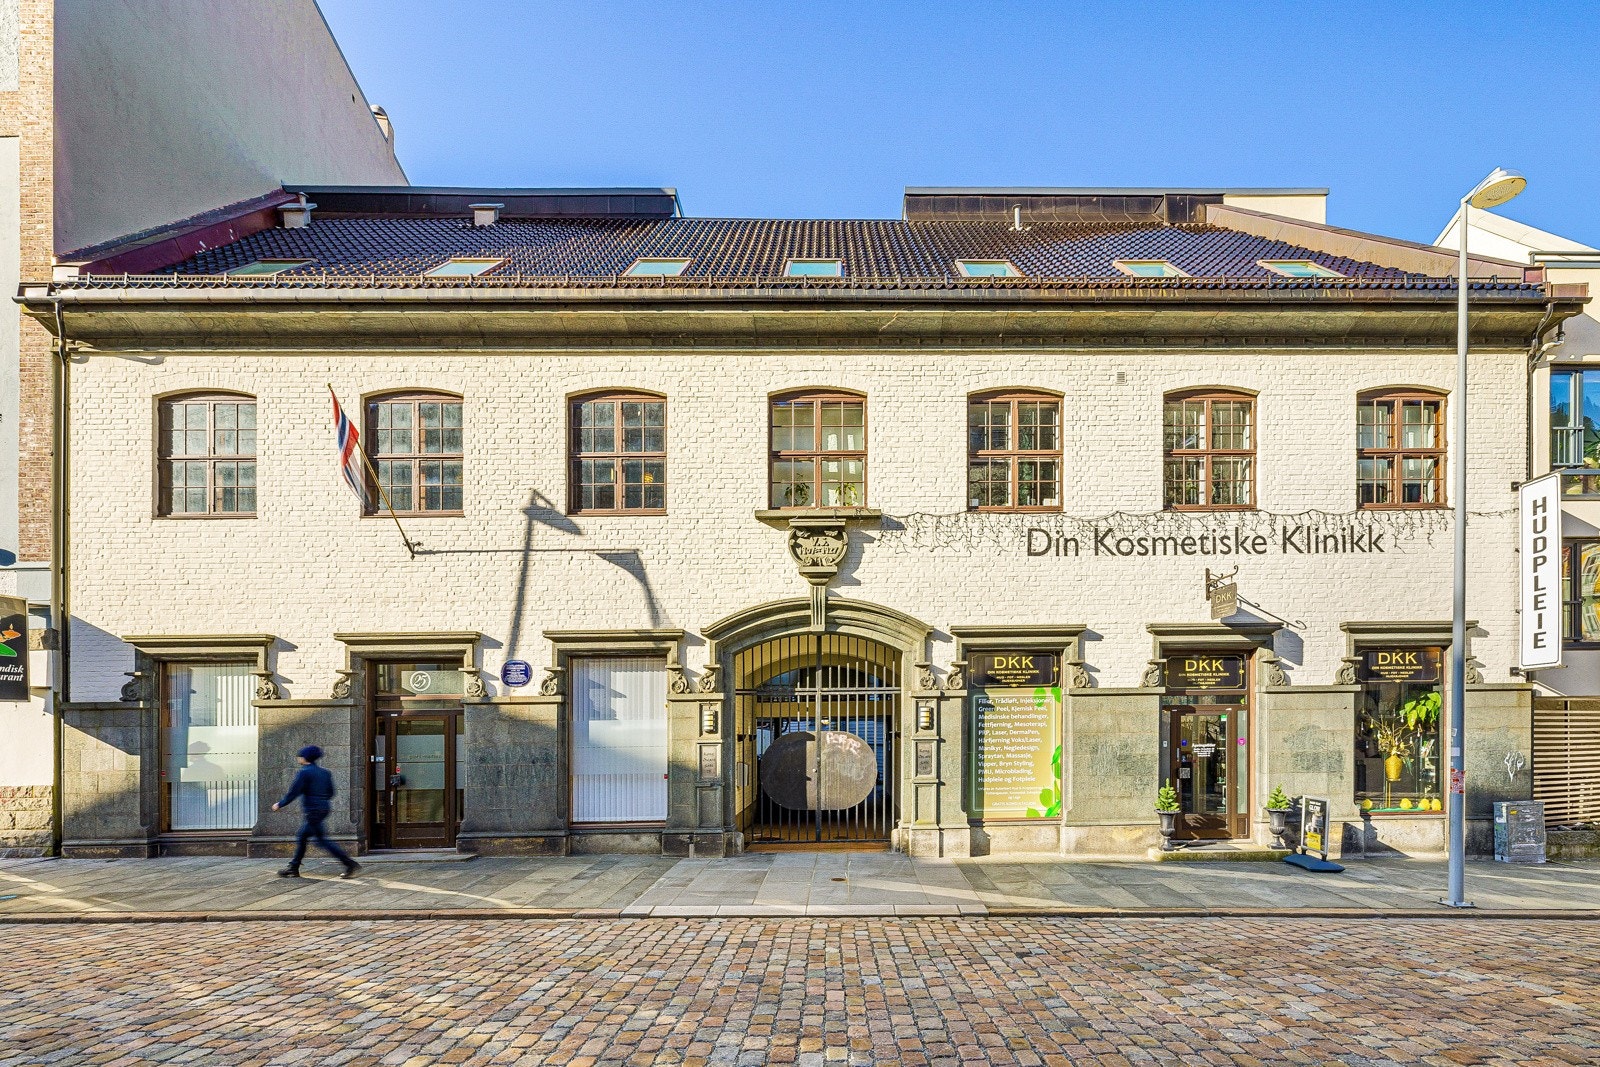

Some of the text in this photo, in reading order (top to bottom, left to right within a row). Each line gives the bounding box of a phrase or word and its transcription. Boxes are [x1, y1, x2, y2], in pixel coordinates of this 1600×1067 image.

[1027, 525, 1385, 557] Din Kosmetiske Klinikk
[1532, 496, 1547, 649] HUDPLEIE
[1215, 591, 1232, 603] DKK
[994, 656, 1034, 669] DKK
[1378, 652, 1417, 664] DKK
[1185, 660, 1224, 671] DKK
[413, 675, 427, 689] 25
